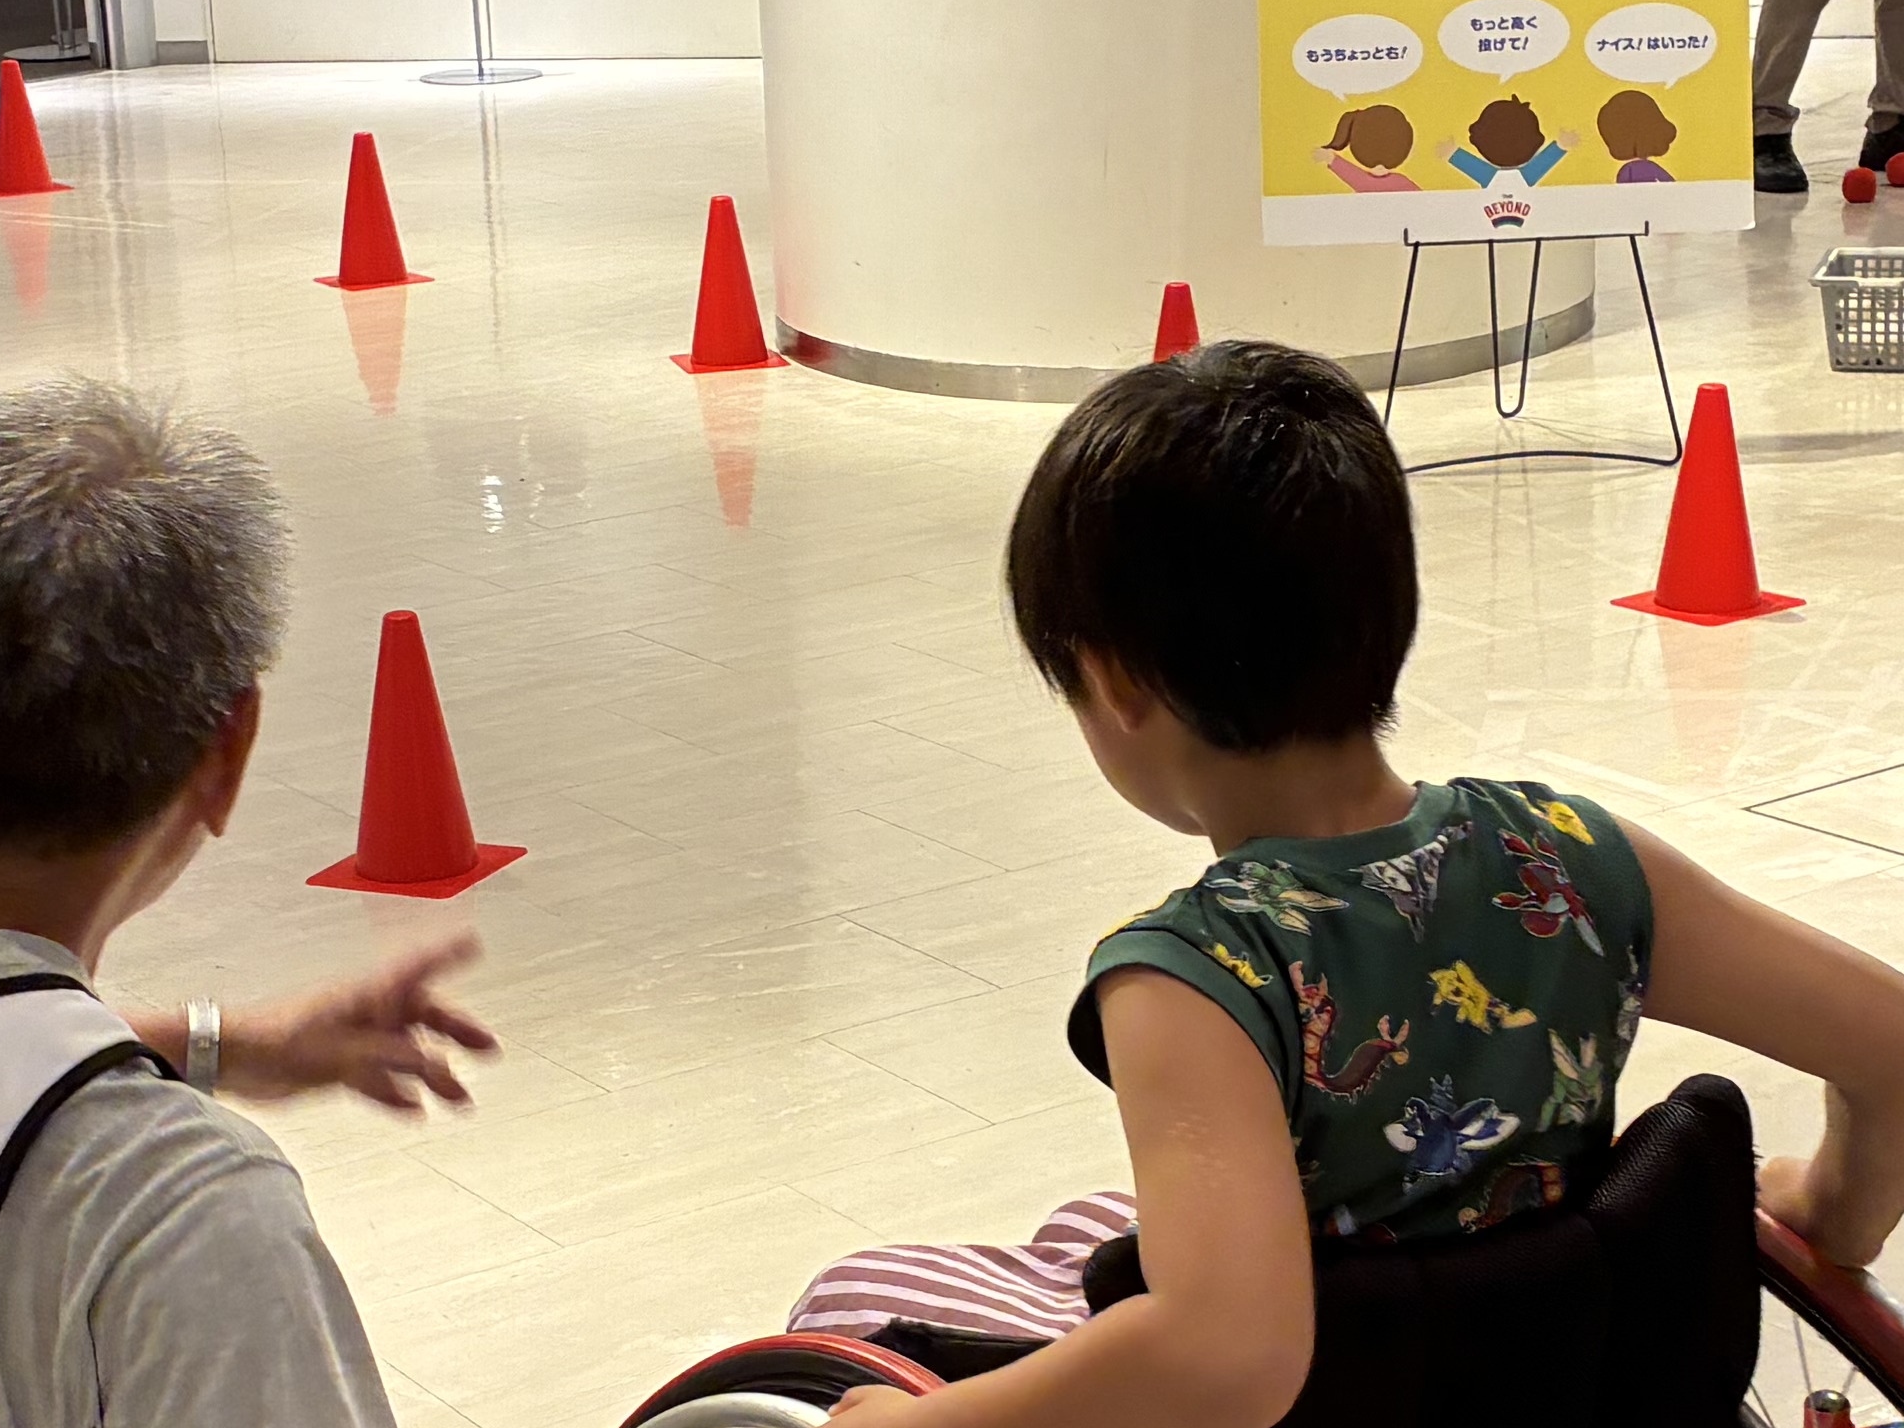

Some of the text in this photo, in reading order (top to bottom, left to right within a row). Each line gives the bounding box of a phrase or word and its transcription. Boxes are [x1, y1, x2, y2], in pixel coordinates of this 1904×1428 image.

[1470, 15, 1538, 32] もっと高く
[1478, 35, 1530, 53] 投げて!
[1306, 45, 1409, 63] もうちょっと右!
[1483, 200, 1531, 219] BEYOND
